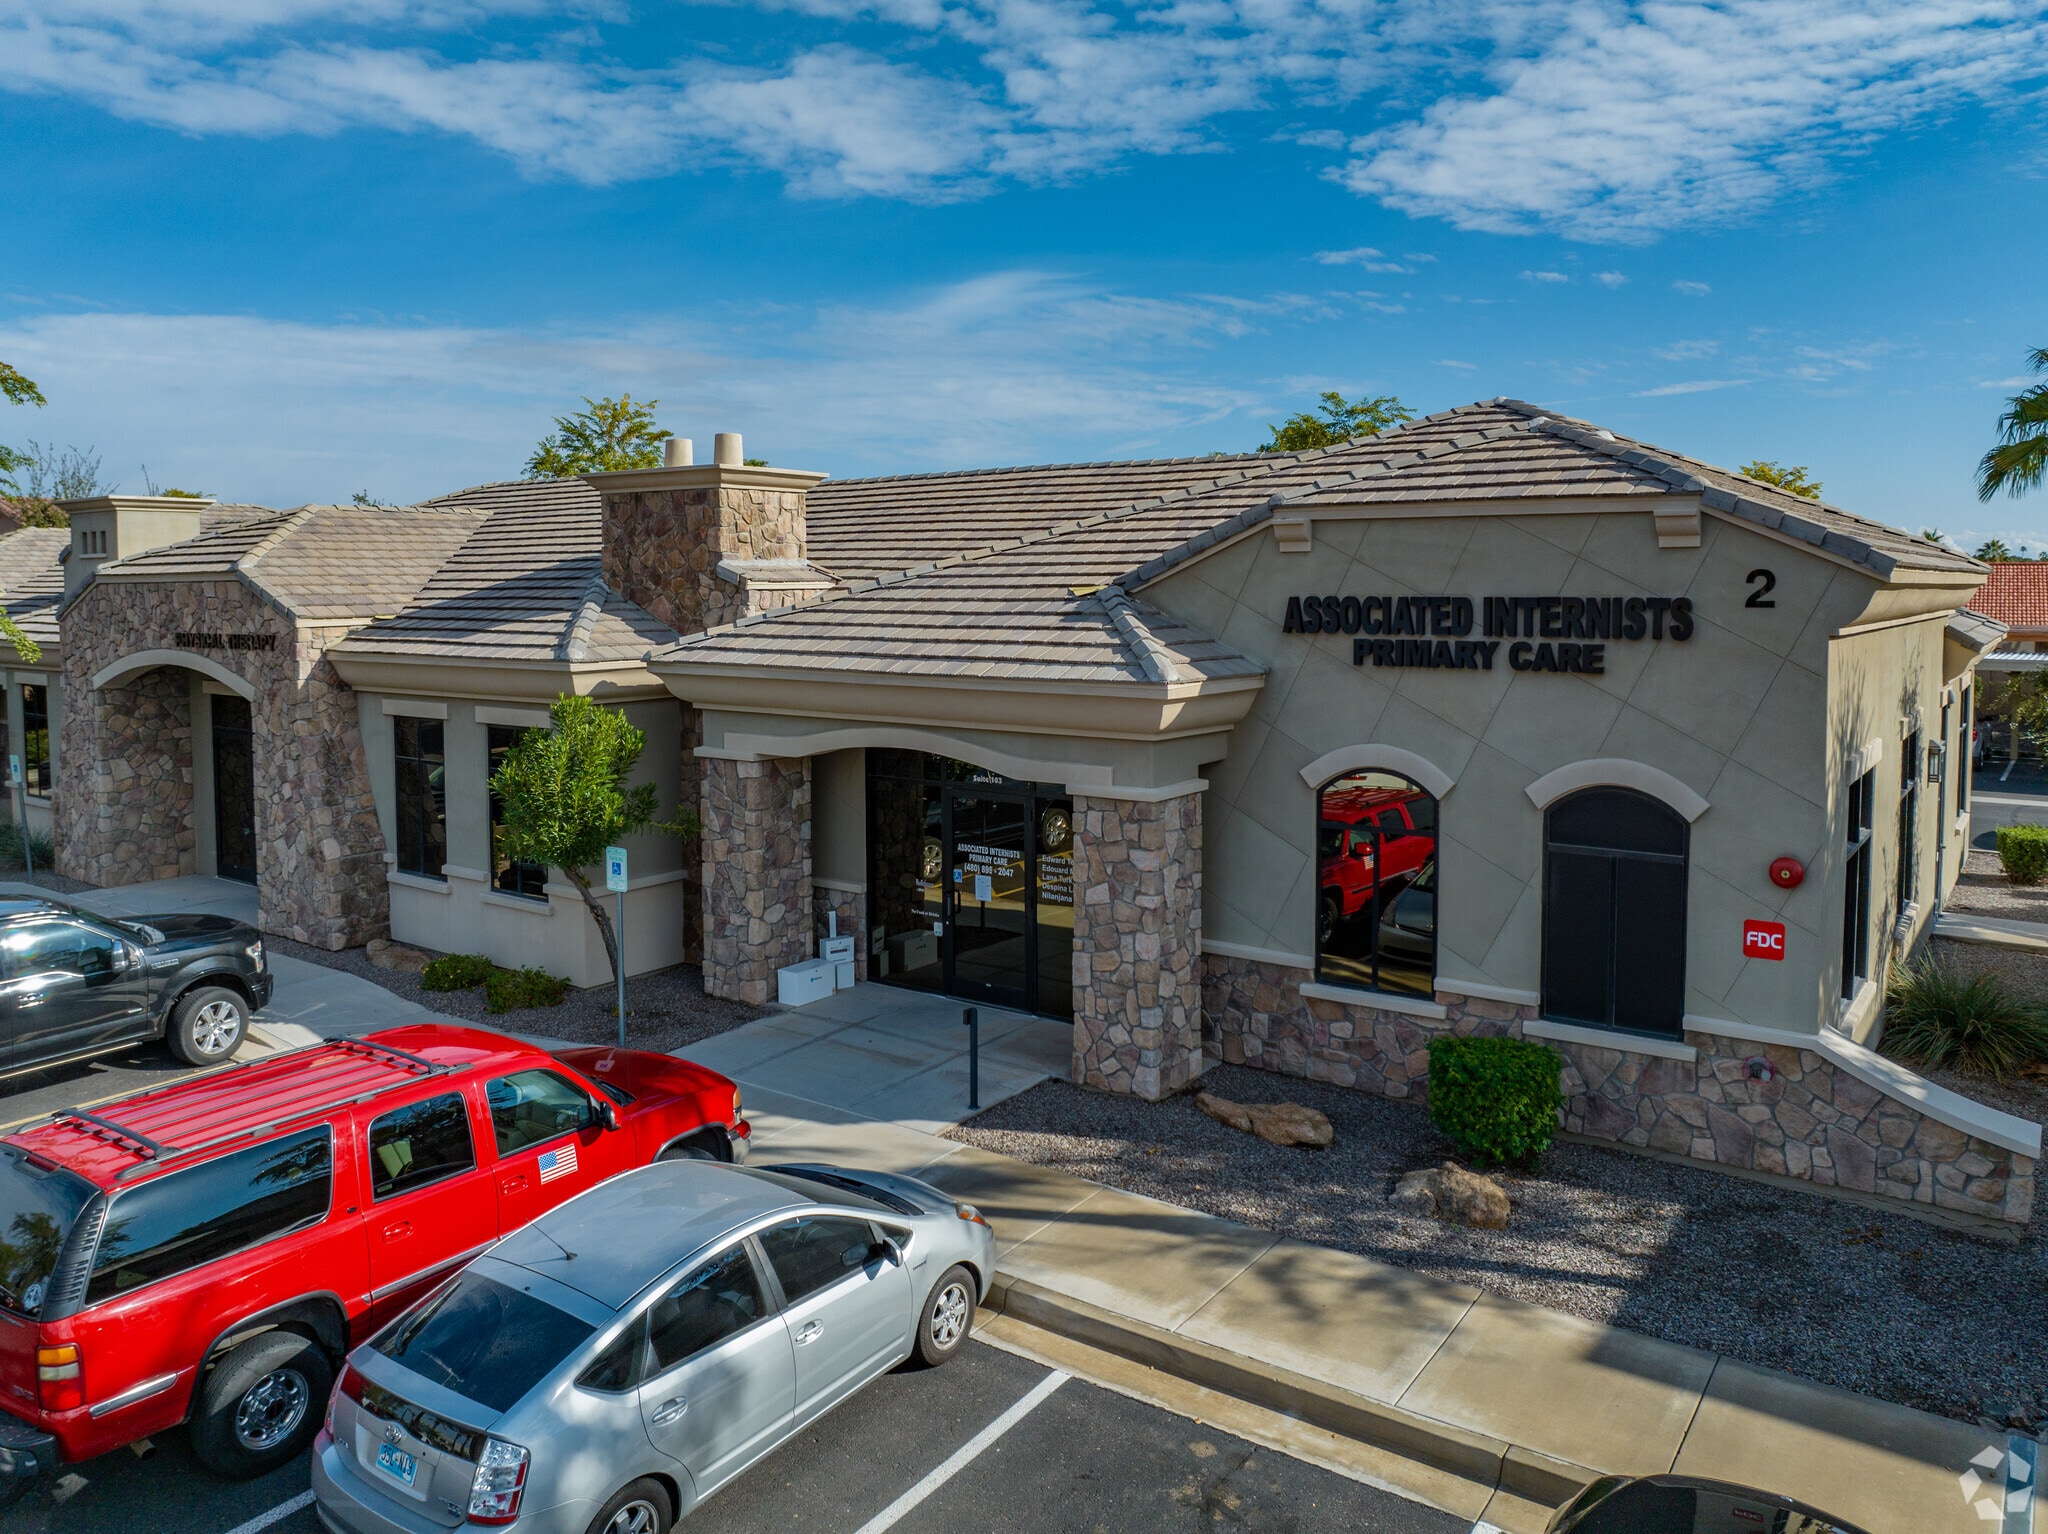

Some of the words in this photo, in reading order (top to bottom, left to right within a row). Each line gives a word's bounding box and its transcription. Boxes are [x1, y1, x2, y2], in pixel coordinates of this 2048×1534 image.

[1745, 569, 1777, 608] 2
[1282, 595, 1474, 638] ASSOCIATED
[1483, 596, 1695, 641] INTERNISTS
[176, 632, 226, 649] PHYSICAL
[226, 633, 277, 652] THERAPY
[1353, 638, 1500, 670] PRIMARY
[1508, 641, 1606, 674] CARE
[957, 843, 989, 855] ASSOCIATED
[989, 847, 1021, 859] INTERNISTS
[968, 853, 993, 863] PRIMARY
[993, 856, 1008, 866] CARE
[1042, 854, 1066, 865] Edward
[964, 862, 980, 874] (480)
[998, 867, 1014, 878] 2047
[1042, 864, 1069, 875] Edouard
[1042, 873, 1058, 882] Lana
[1042, 882, 1068, 893] Despina
[1042, 891, 1073, 903] Nilanjana
[1746, 930, 1783, 950] FDC
